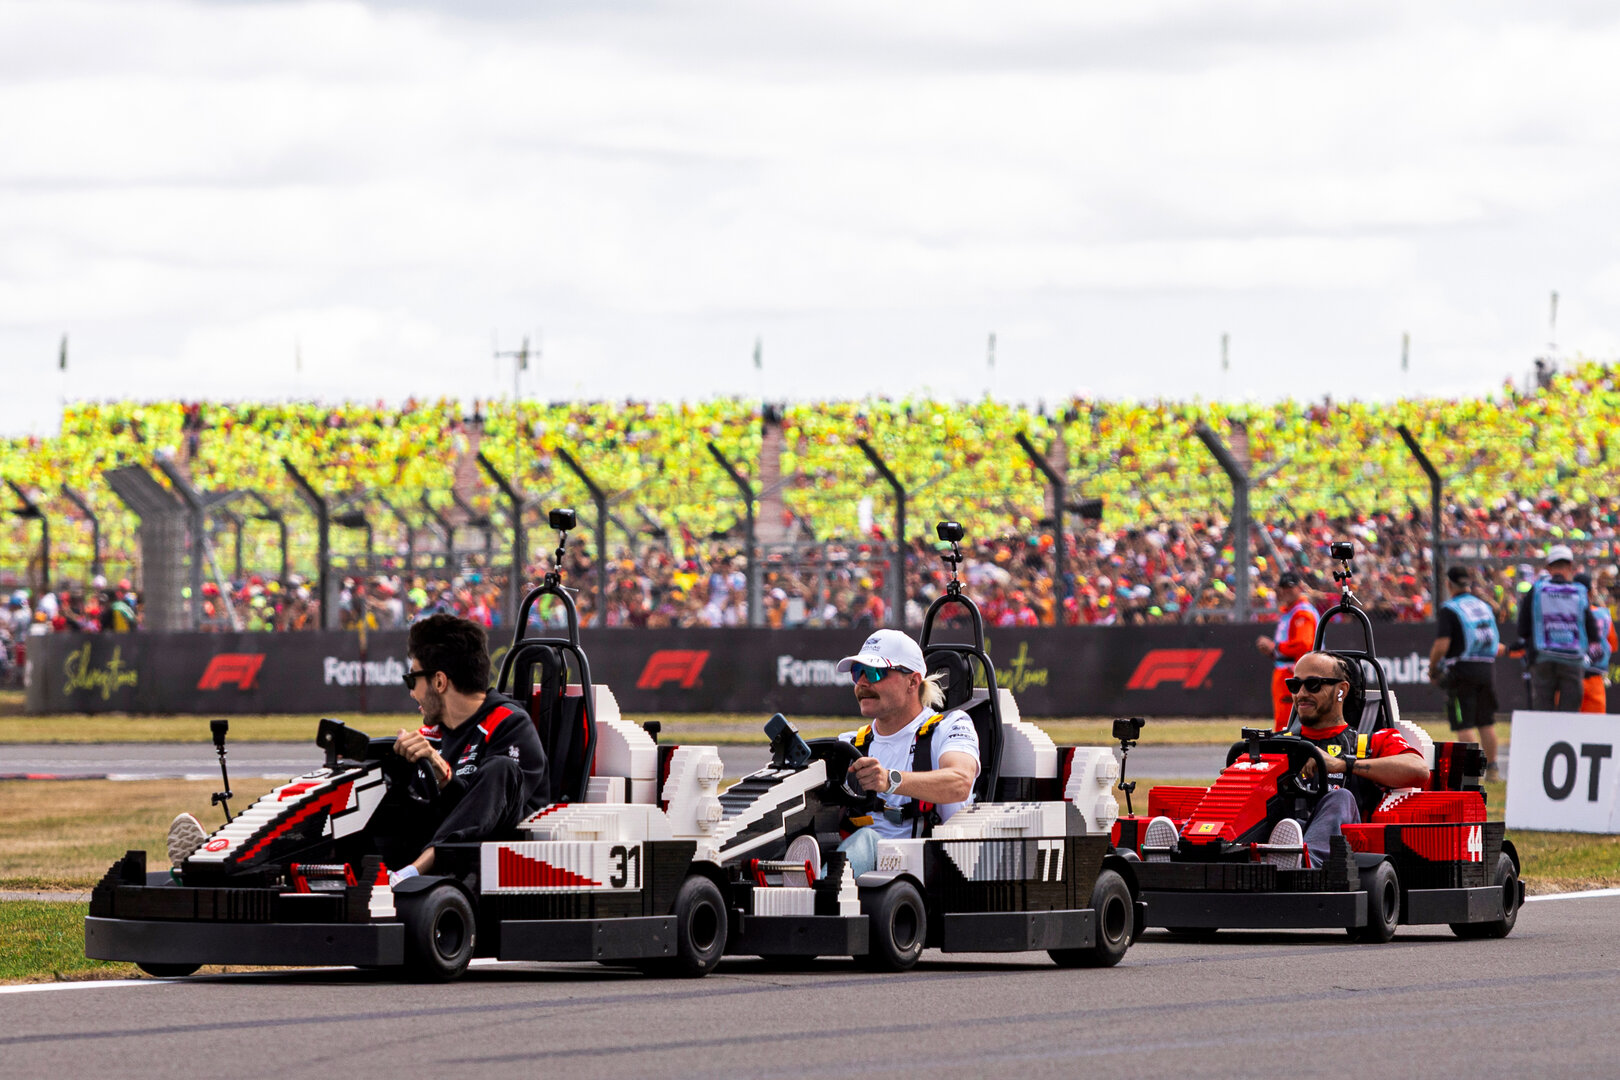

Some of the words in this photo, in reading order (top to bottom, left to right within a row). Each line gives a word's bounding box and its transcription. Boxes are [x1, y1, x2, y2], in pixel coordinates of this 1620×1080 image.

[197, 653, 266, 690] F1
[324, 656, 405, 686] Formula
[636, 650, 711, 689] F1
[1126, 649, 1223, 690] F1
[1542, 740, 1613, 803] OT
[1037, 839, 1064, 882] 77
[1467, 824, 1483, 862] 44
[609, 845, 641, 889] 31
